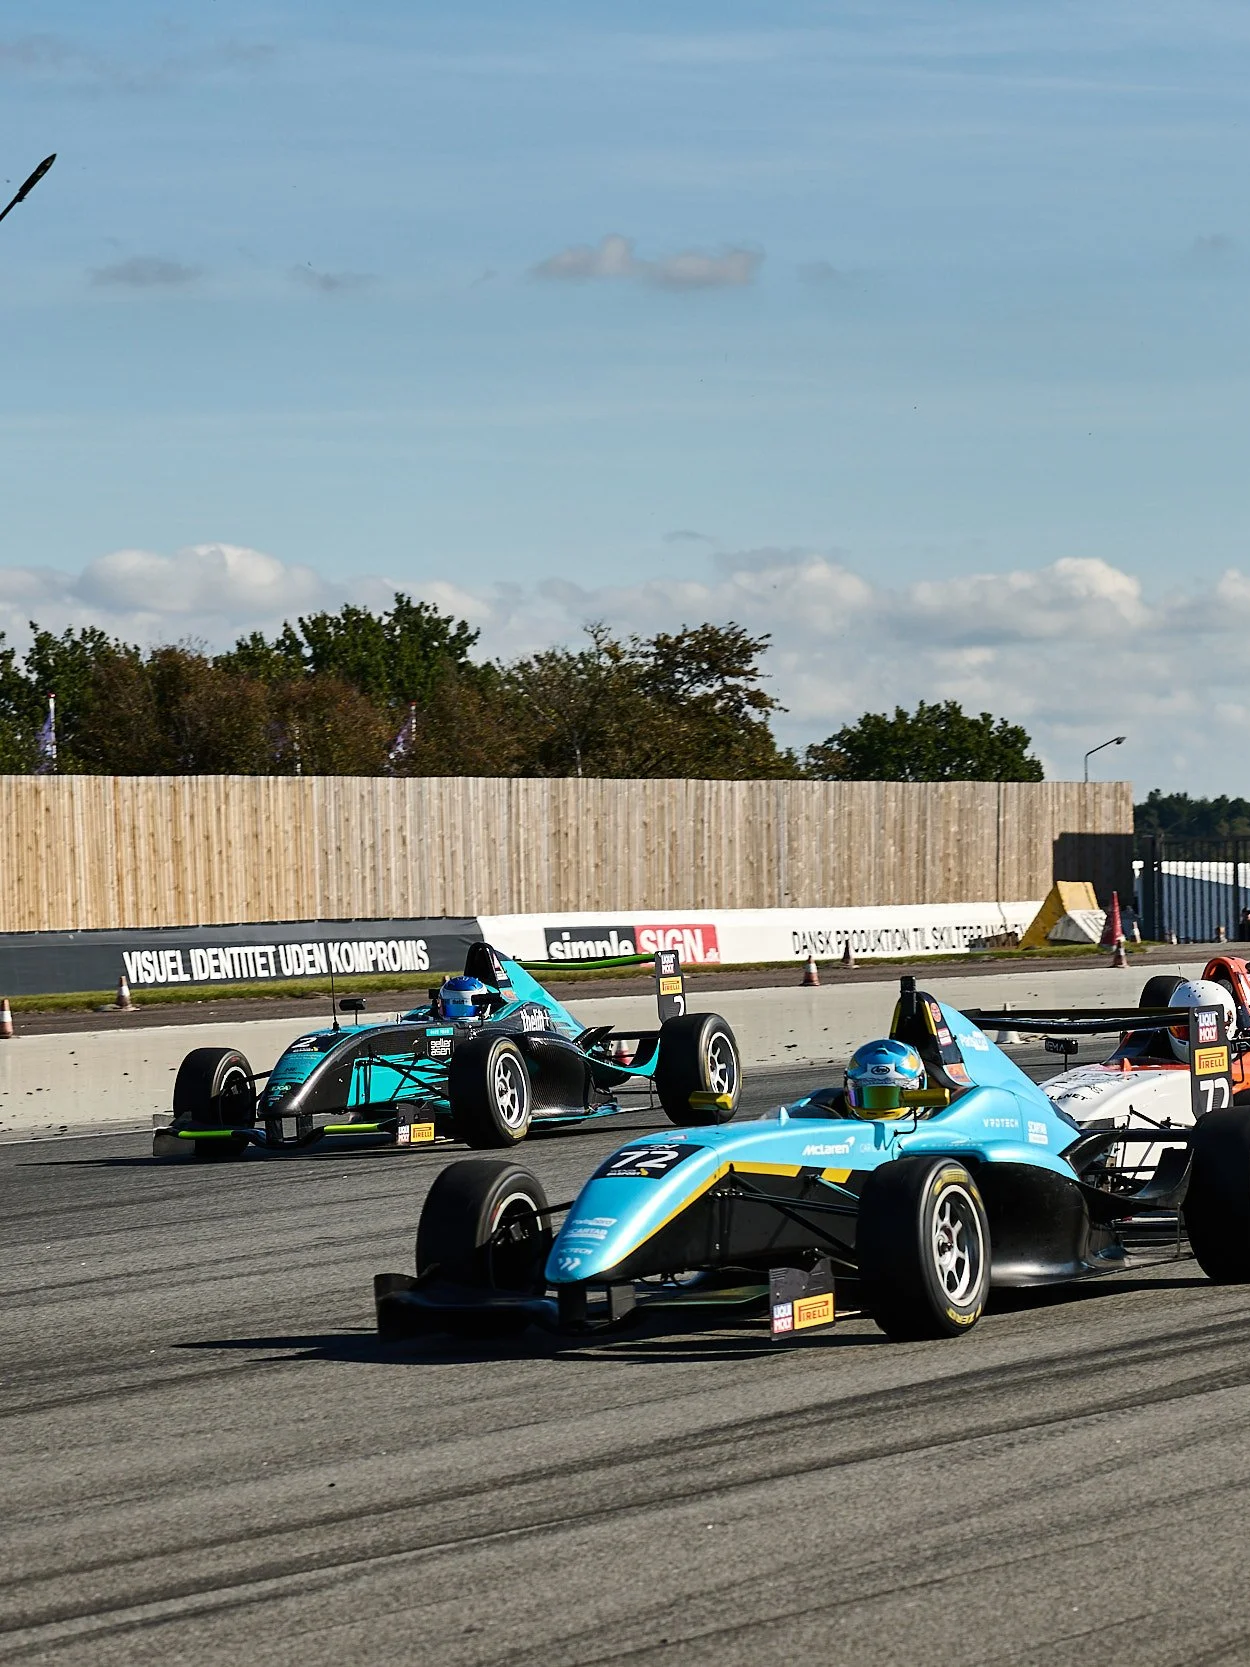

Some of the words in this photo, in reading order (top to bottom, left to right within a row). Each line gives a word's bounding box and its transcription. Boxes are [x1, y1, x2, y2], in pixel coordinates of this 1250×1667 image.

[792, 931, 834, 955] DANSK
[913, 927, 931, 950] TIL
[122, 950, 191, 984] VISUEL
[190, 945, 277, 981] IDENTITET
[277, 943, 329, 977] UDEN
[328, 940, 430, 974] KOMPROMIS
[291, 1037, 317, 1049] 2
[1199, 1052, 1225, 1070] PIRELLI
[1200, 1077, 1230, 1113] 72
[802, 1142, 850, 1156] McLaren
[611, 1150, 679, 1169] 72
[798, 1300, 829, 1322] PIRELLI
